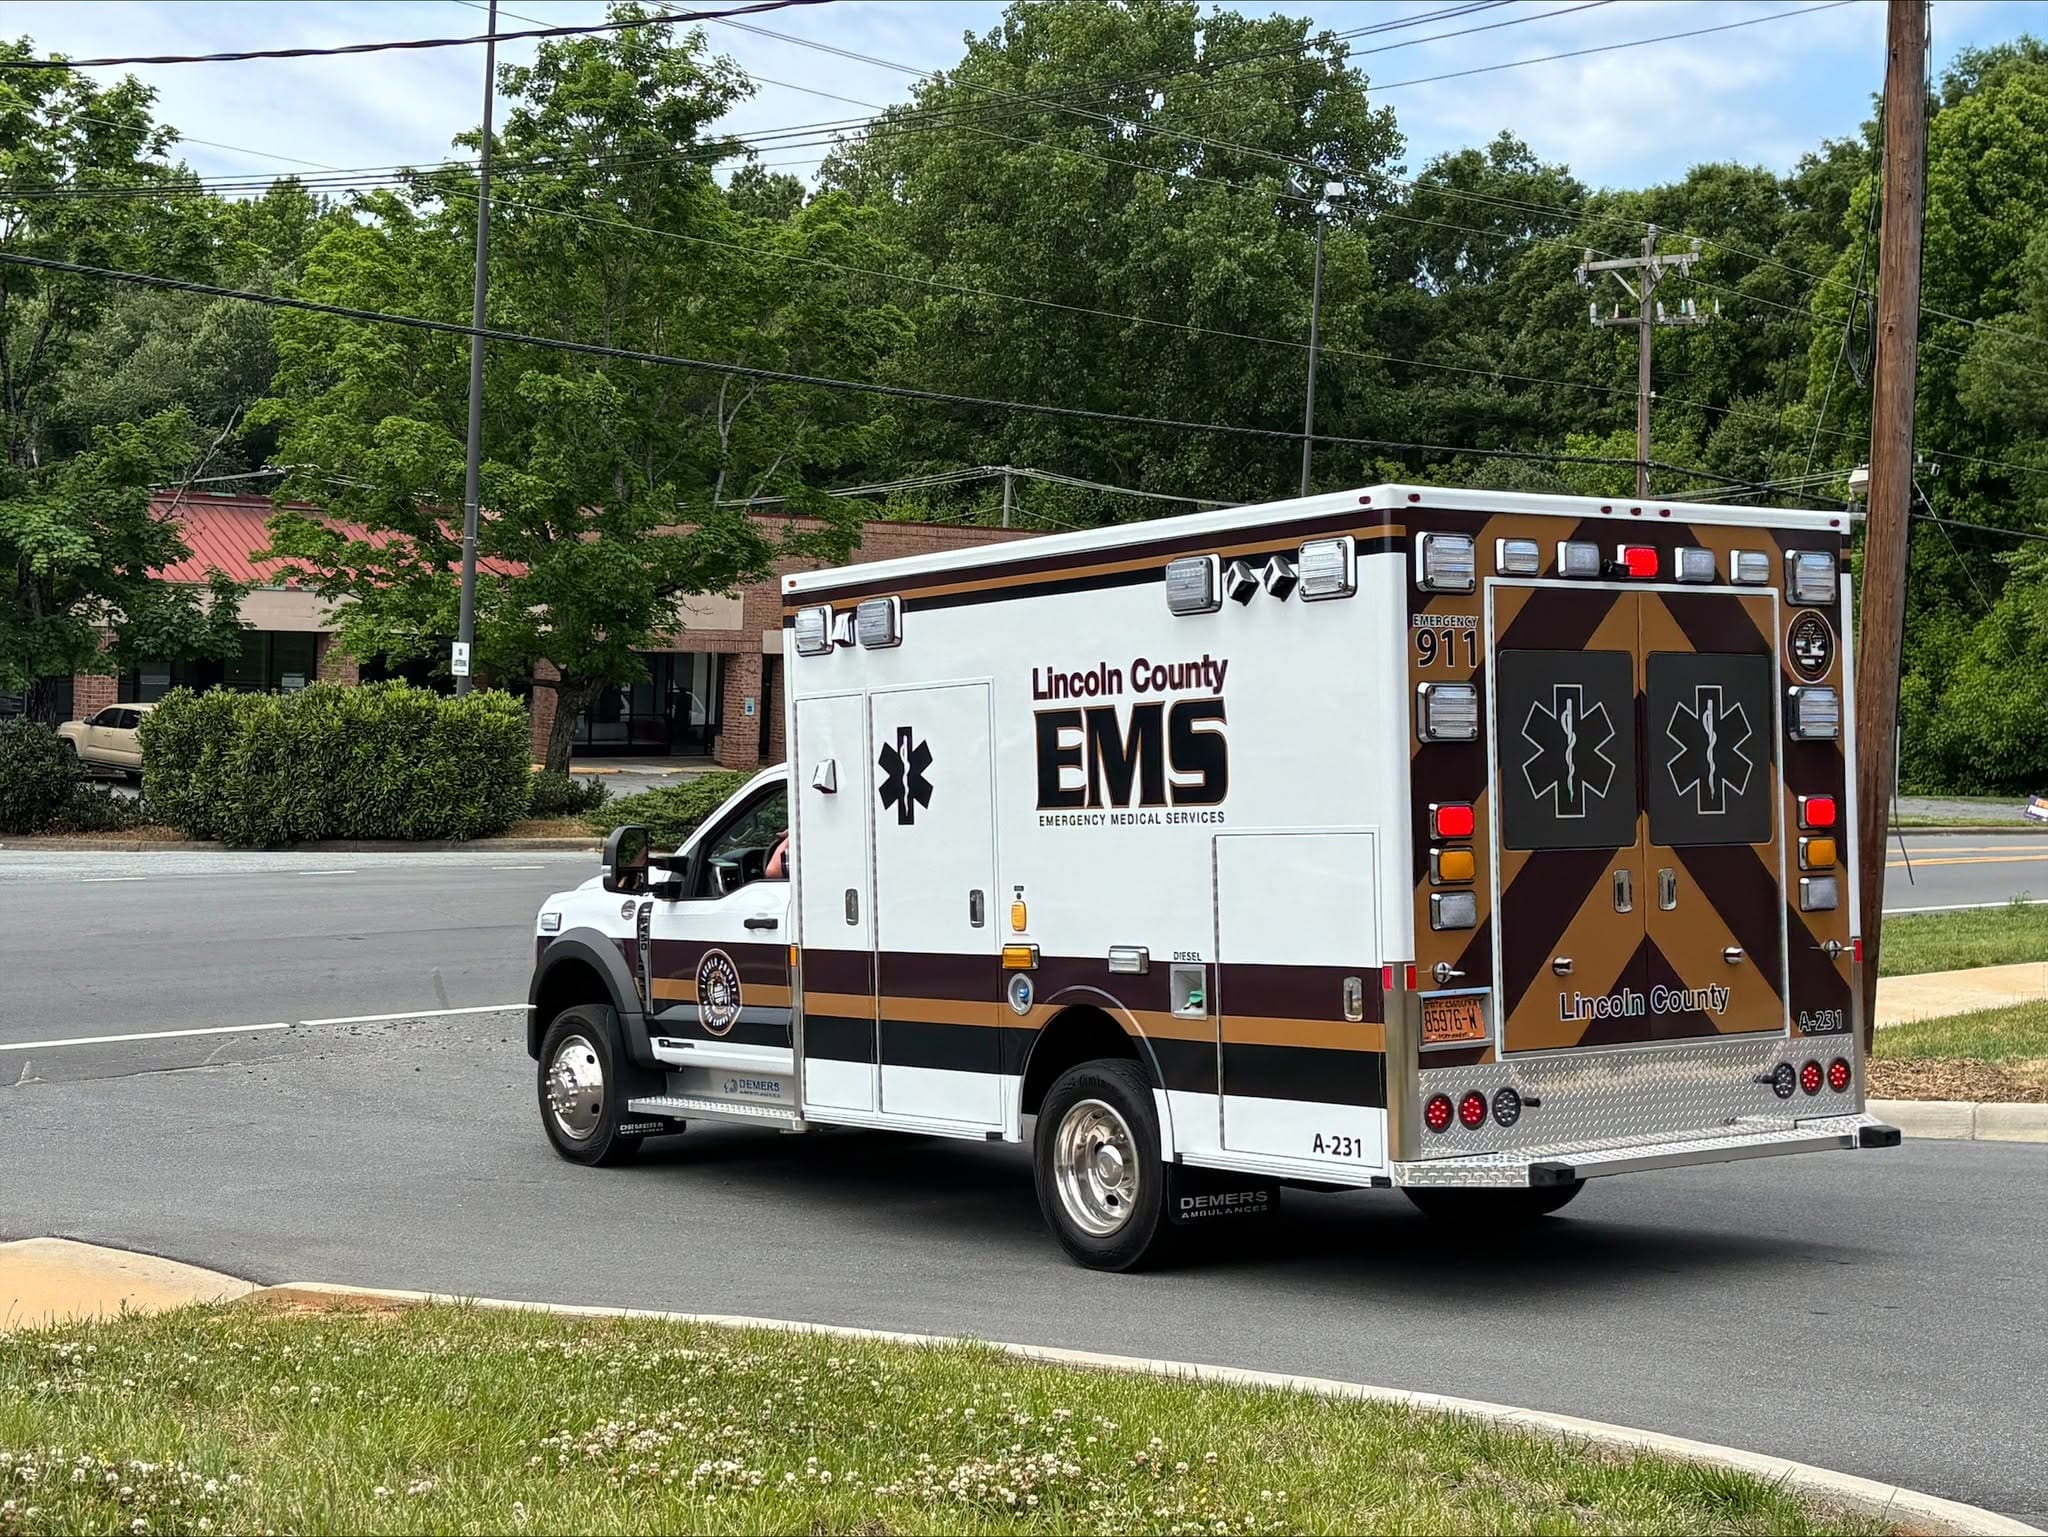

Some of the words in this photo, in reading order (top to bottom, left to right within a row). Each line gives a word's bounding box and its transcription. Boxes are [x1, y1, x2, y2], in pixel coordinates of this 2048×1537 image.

[1412, 614, 1479, 628] EMERGENCY
[1415, 627, 1478, 669] 911
[1032, 662, 1123, 700] Lincoln
[1131, 654, 1229, 694] County
[1033, 696, 1229, 811] EMS
[1039, 814, 1106, 827] EMERGENCY
[1111, 812, 1161, 826] MEDICAL
[1166, 811, 1225, 824] SERVICES
[1173, 951, 1202, 962] DIESEL
[1559, 988, 1645, 1021] Lincoln
[1650, 983, 1730, 1014] County
[1799, 1009, 1844, 1031] A-231
[739, 1079, 780, 1092] DEMERS
[1312, 1133, 1362, 1158] A-231
[1180, 1191, 1268, 1210] DEMERS
